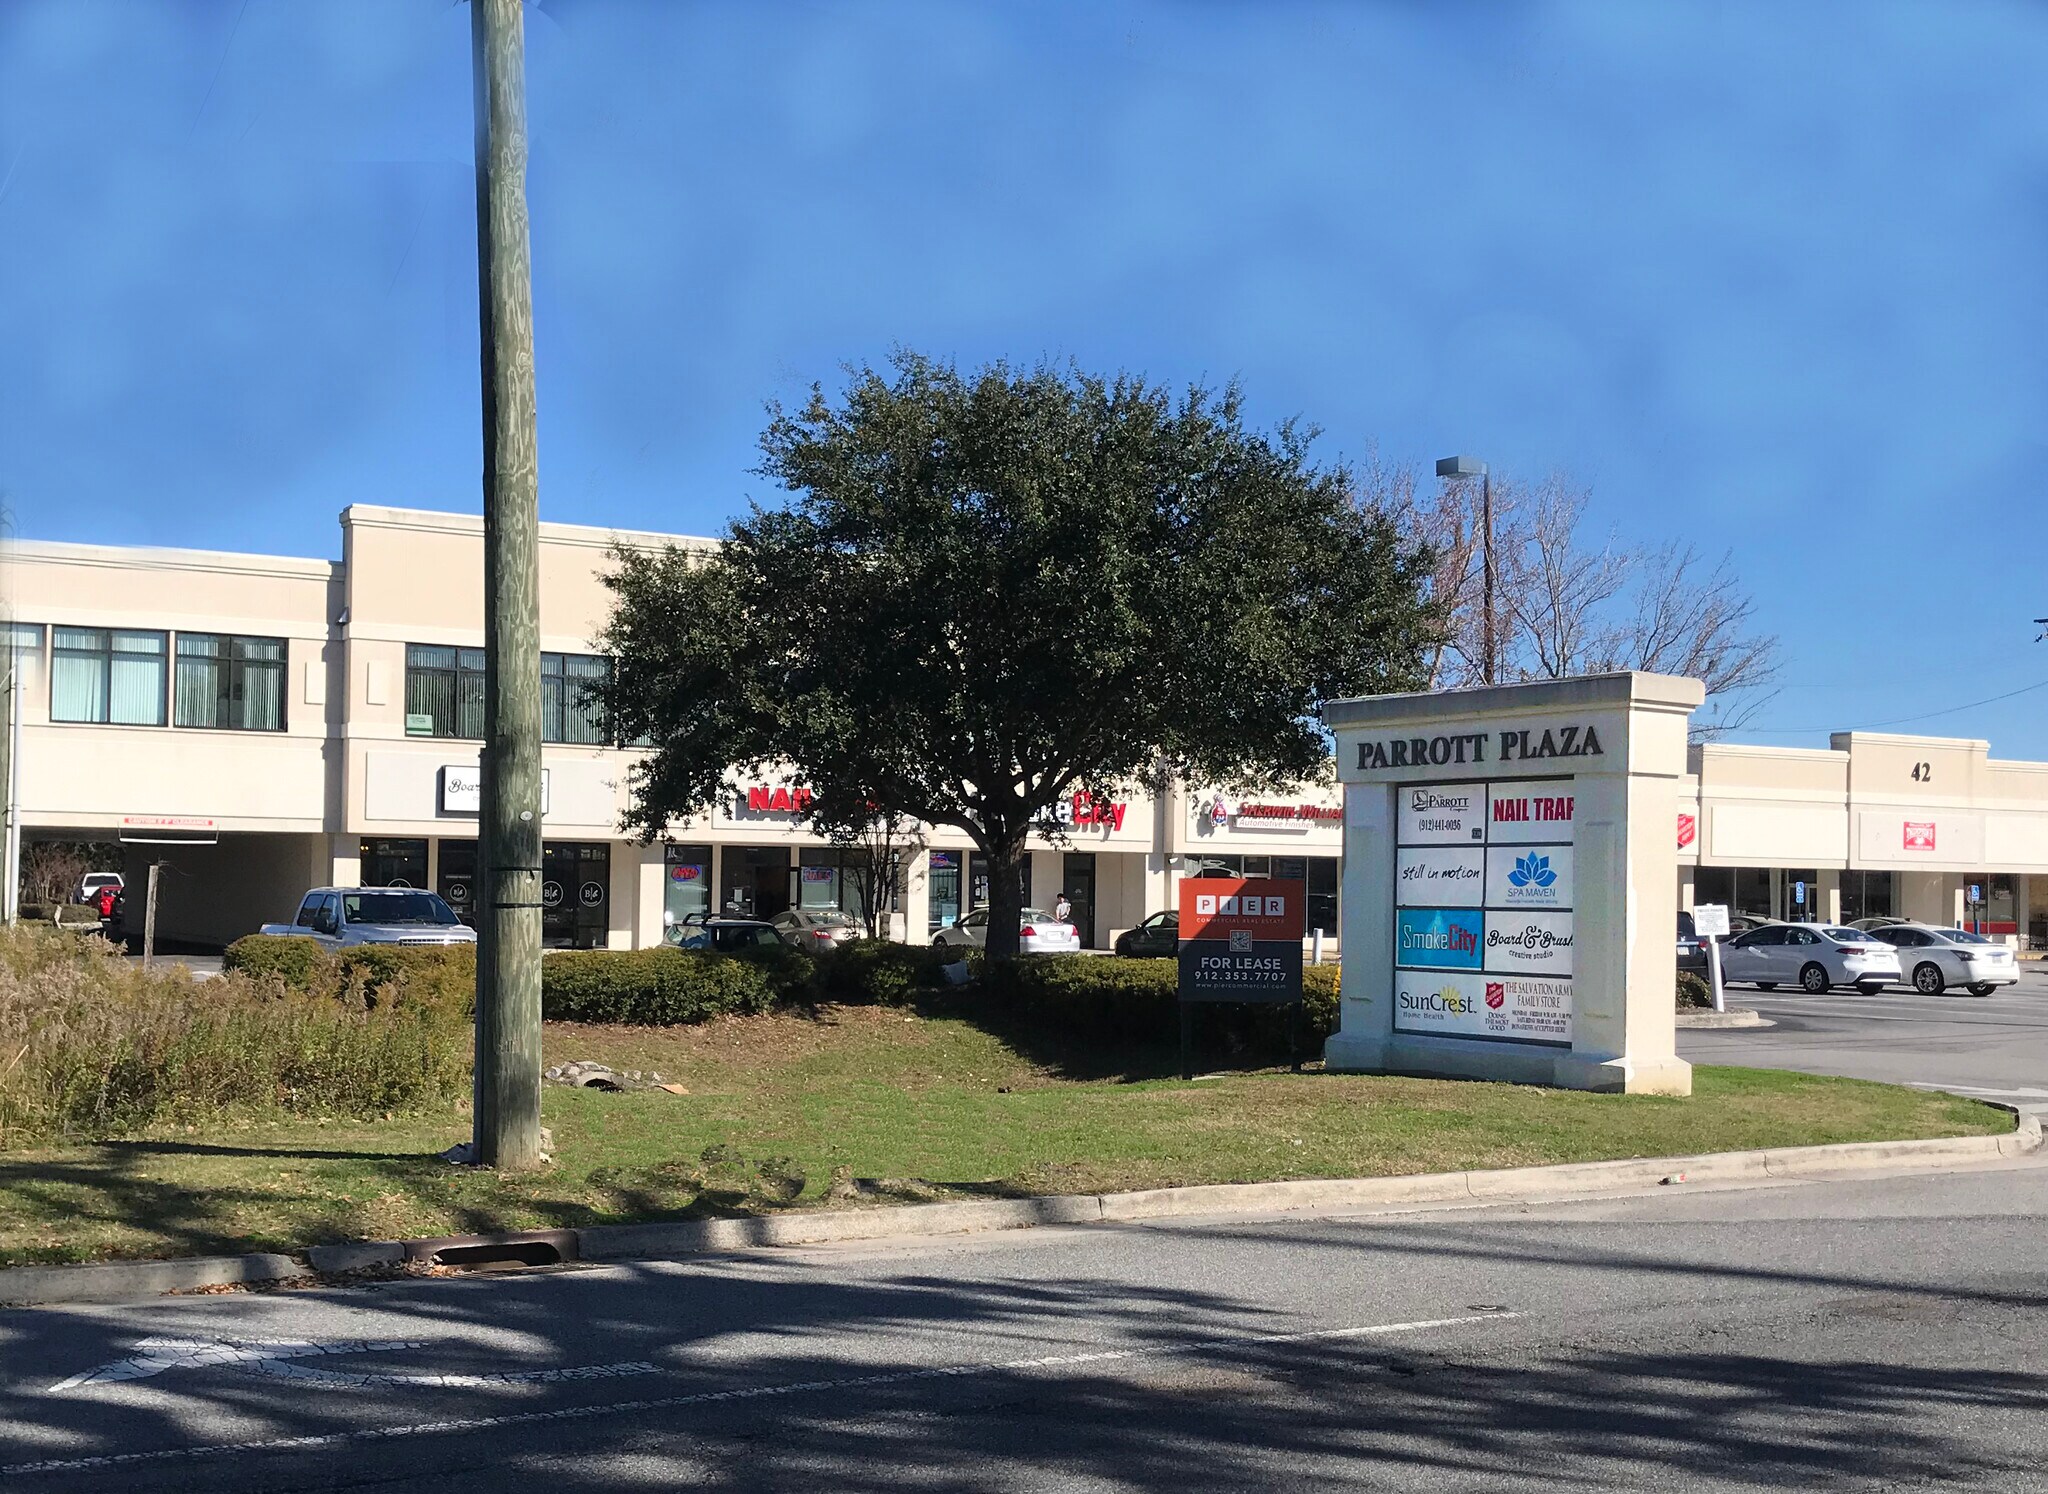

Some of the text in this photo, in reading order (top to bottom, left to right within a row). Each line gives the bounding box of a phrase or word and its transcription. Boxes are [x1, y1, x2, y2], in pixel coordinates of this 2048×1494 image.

[1357, 726, 1604, 769] PARROTT PLAZA
[1910, 762, 1931, 782] 42
[1493, 798, 1530, 821] NAIL
[1238, 819, 1314, 829] Automotive Finishes
[1402, 864, 1480, 880] still in motion
[1507, 888, 1556, 897] SPA MAVEN
[1202, 899, 1280, 911] PIER
[1487, 930, 1524, 947] Board
[1524, 925, 1542, 949] &
[1508, 950, 1554, 960] creative studio
[1201, 957, 1281, 970] FOR LEASE
[1194, 971, 1287, 981] 912.353.7707
[1505, 982, 1517, 993] THE
[1518, 982, 1554, 995] SALVATION
[1400, 991, 1473, 1013] SunCrest
[1517, 995, 1561, 1009] FAMILY STORE
[1402, 1011, 1445, 1020] Home Health
[1488, 1011, 1507, 1019] DOING
